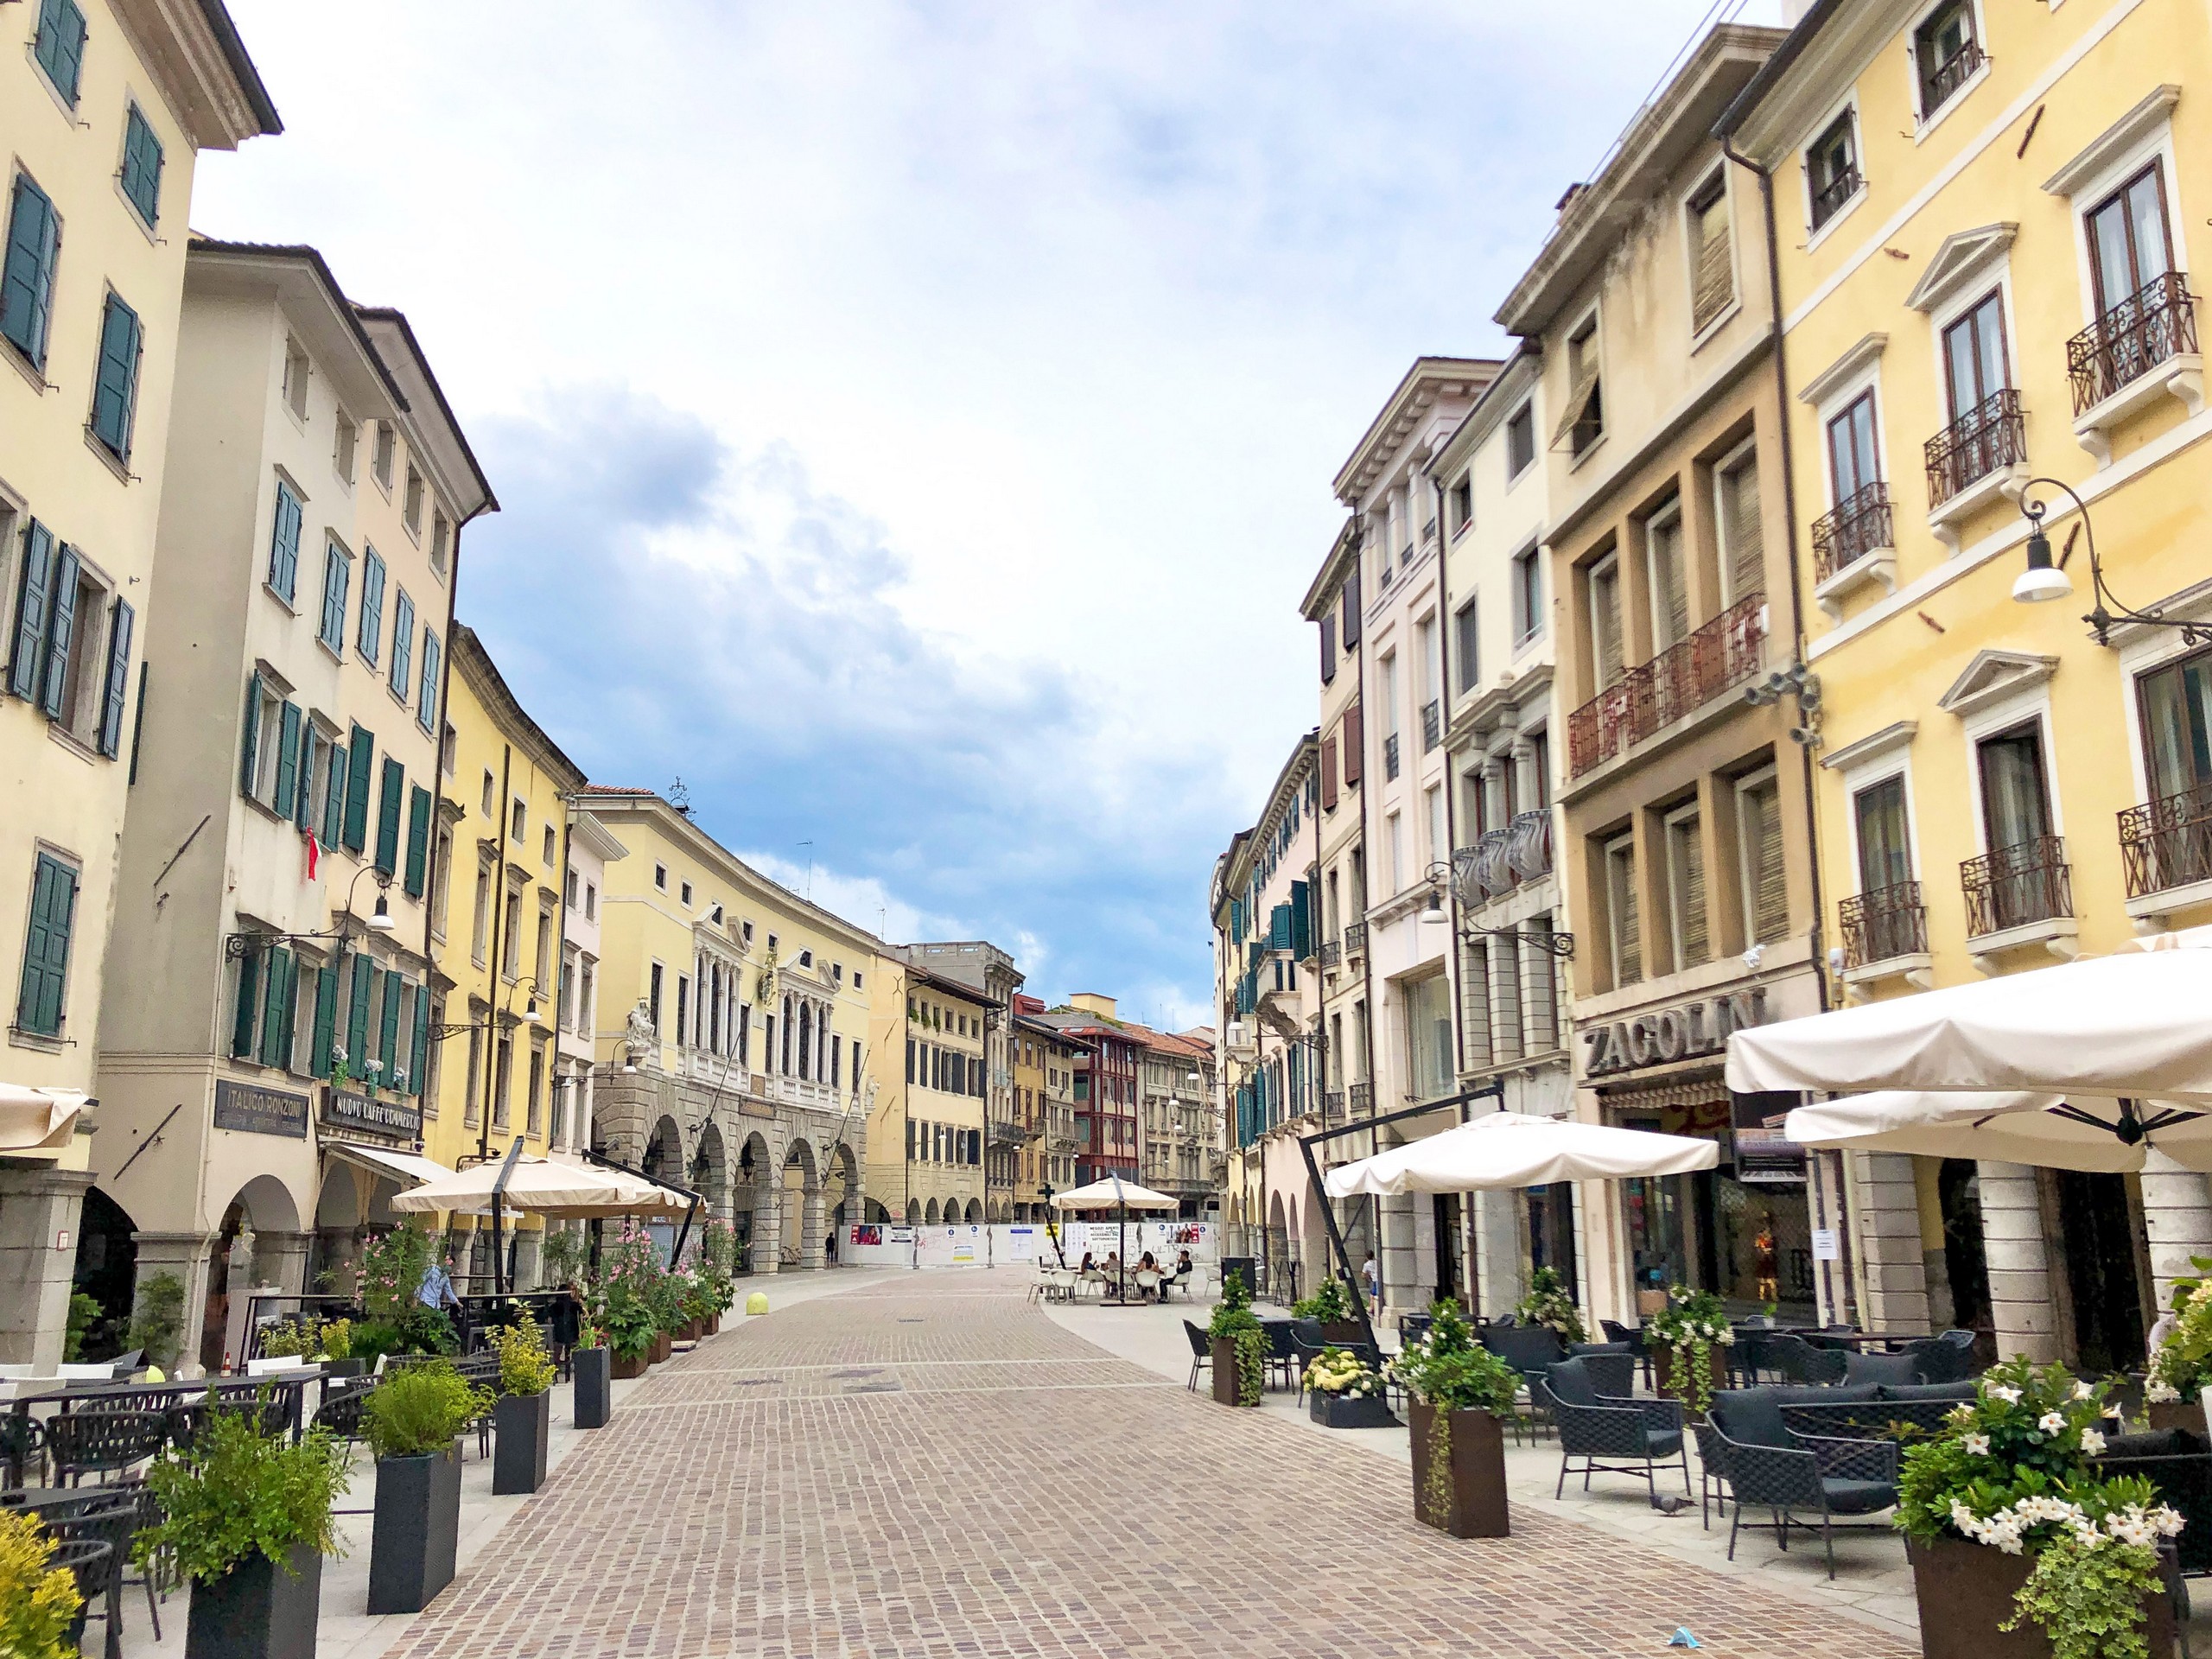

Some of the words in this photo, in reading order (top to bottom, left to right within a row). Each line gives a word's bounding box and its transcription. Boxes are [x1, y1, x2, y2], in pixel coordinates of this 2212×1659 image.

[1584, 988, 1766, 1077] ZAGOLIN
[227, 1089, 264, 1112] ITALICO
[266, 1096, 302, 1118] RONZONI
[336, 1096, 362, 1117] NUOVO
[385, 1109, 421, 1131] COMMERCIO
[1151, 1244, 1193, 1254] ULTRAS
